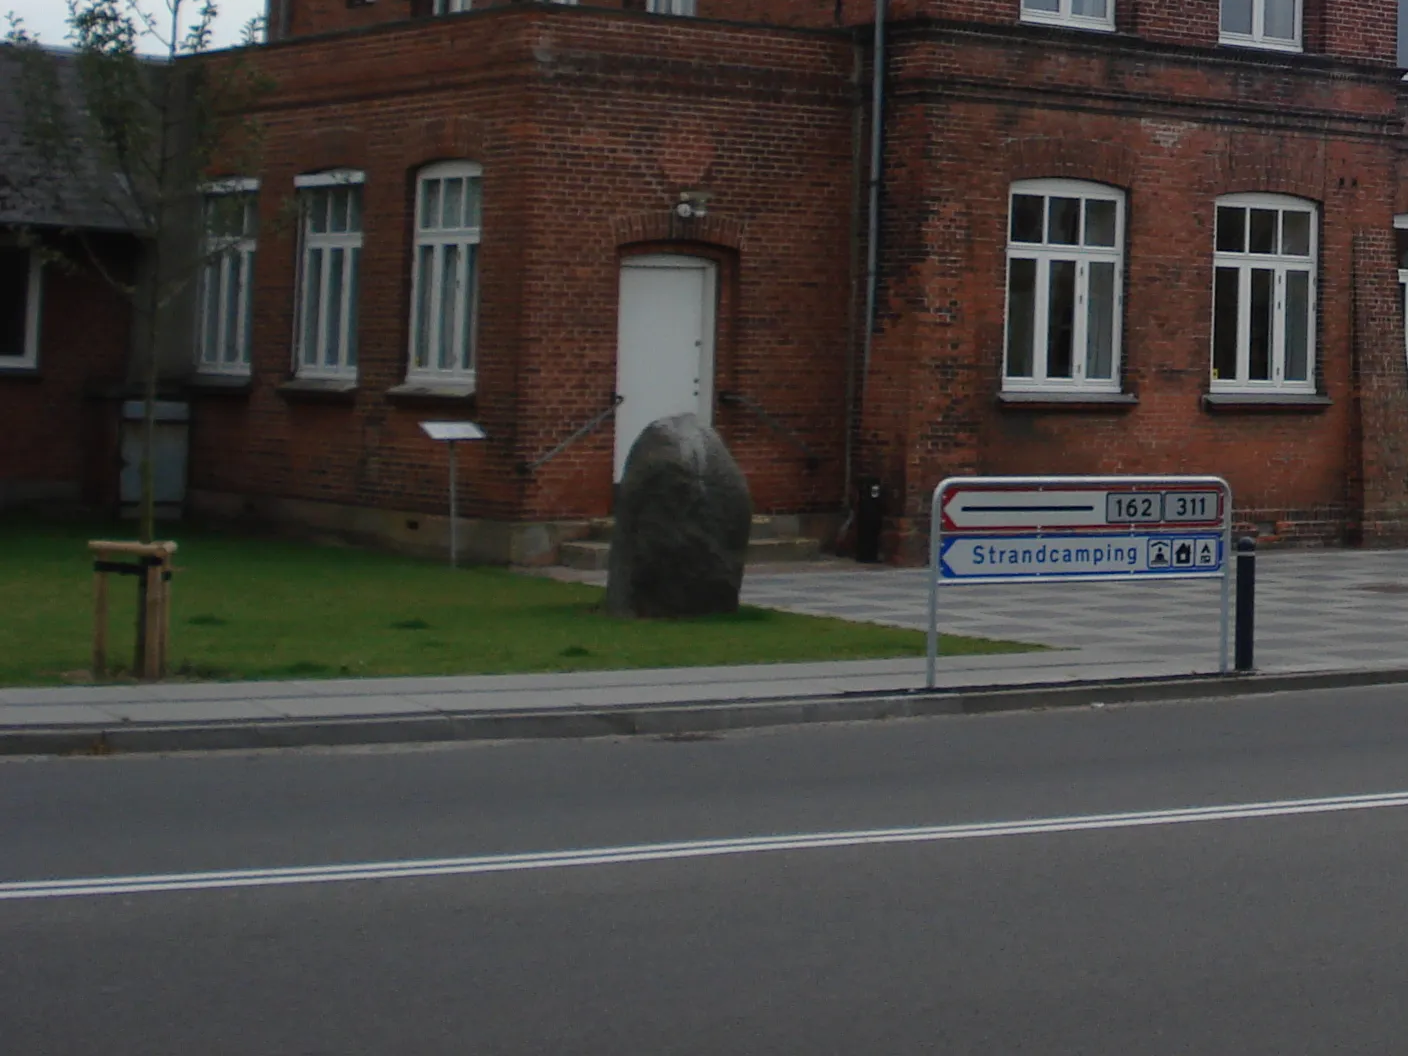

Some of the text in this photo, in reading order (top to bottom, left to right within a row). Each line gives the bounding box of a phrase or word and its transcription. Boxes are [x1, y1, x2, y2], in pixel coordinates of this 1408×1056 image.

[1115, 497, 1205, 518] 162 311
[972, 544, 1138, 566] Strandcamping
